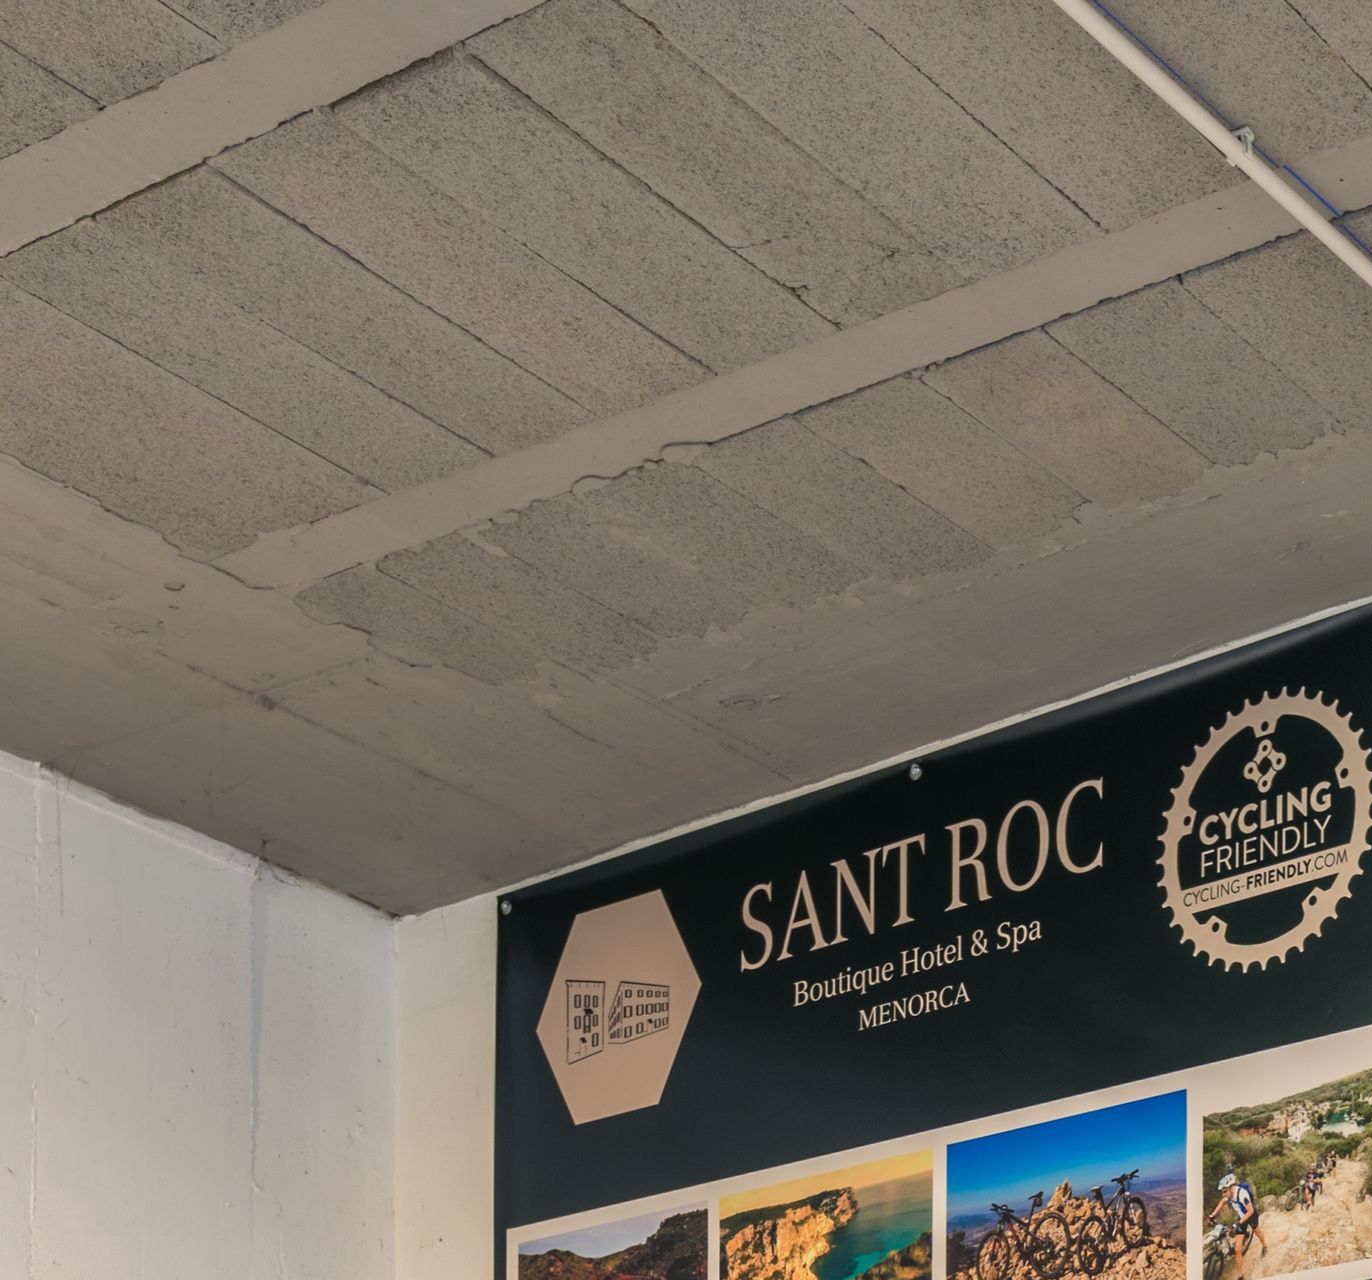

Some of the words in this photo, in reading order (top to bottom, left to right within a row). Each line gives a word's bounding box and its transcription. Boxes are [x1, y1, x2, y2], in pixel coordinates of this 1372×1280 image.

[1199, 780, 1331, 846] CYCLING
[740, 833, 925, 972] SANT
[944, 776, 1103, 912] ROC
[1183, 849, 1348, 907] CYCLING-FRIENDLY.COM
[1201, 814, 1332, 878] FRIENDLY
[793, 961, 894, 1007] Boutique
[900, 935, 963, 977] Hotel
[970, 928, 989, 957] &
[996, 920, 1042, 952] Spa
[858, 982, 971, 1031] MENORCA
